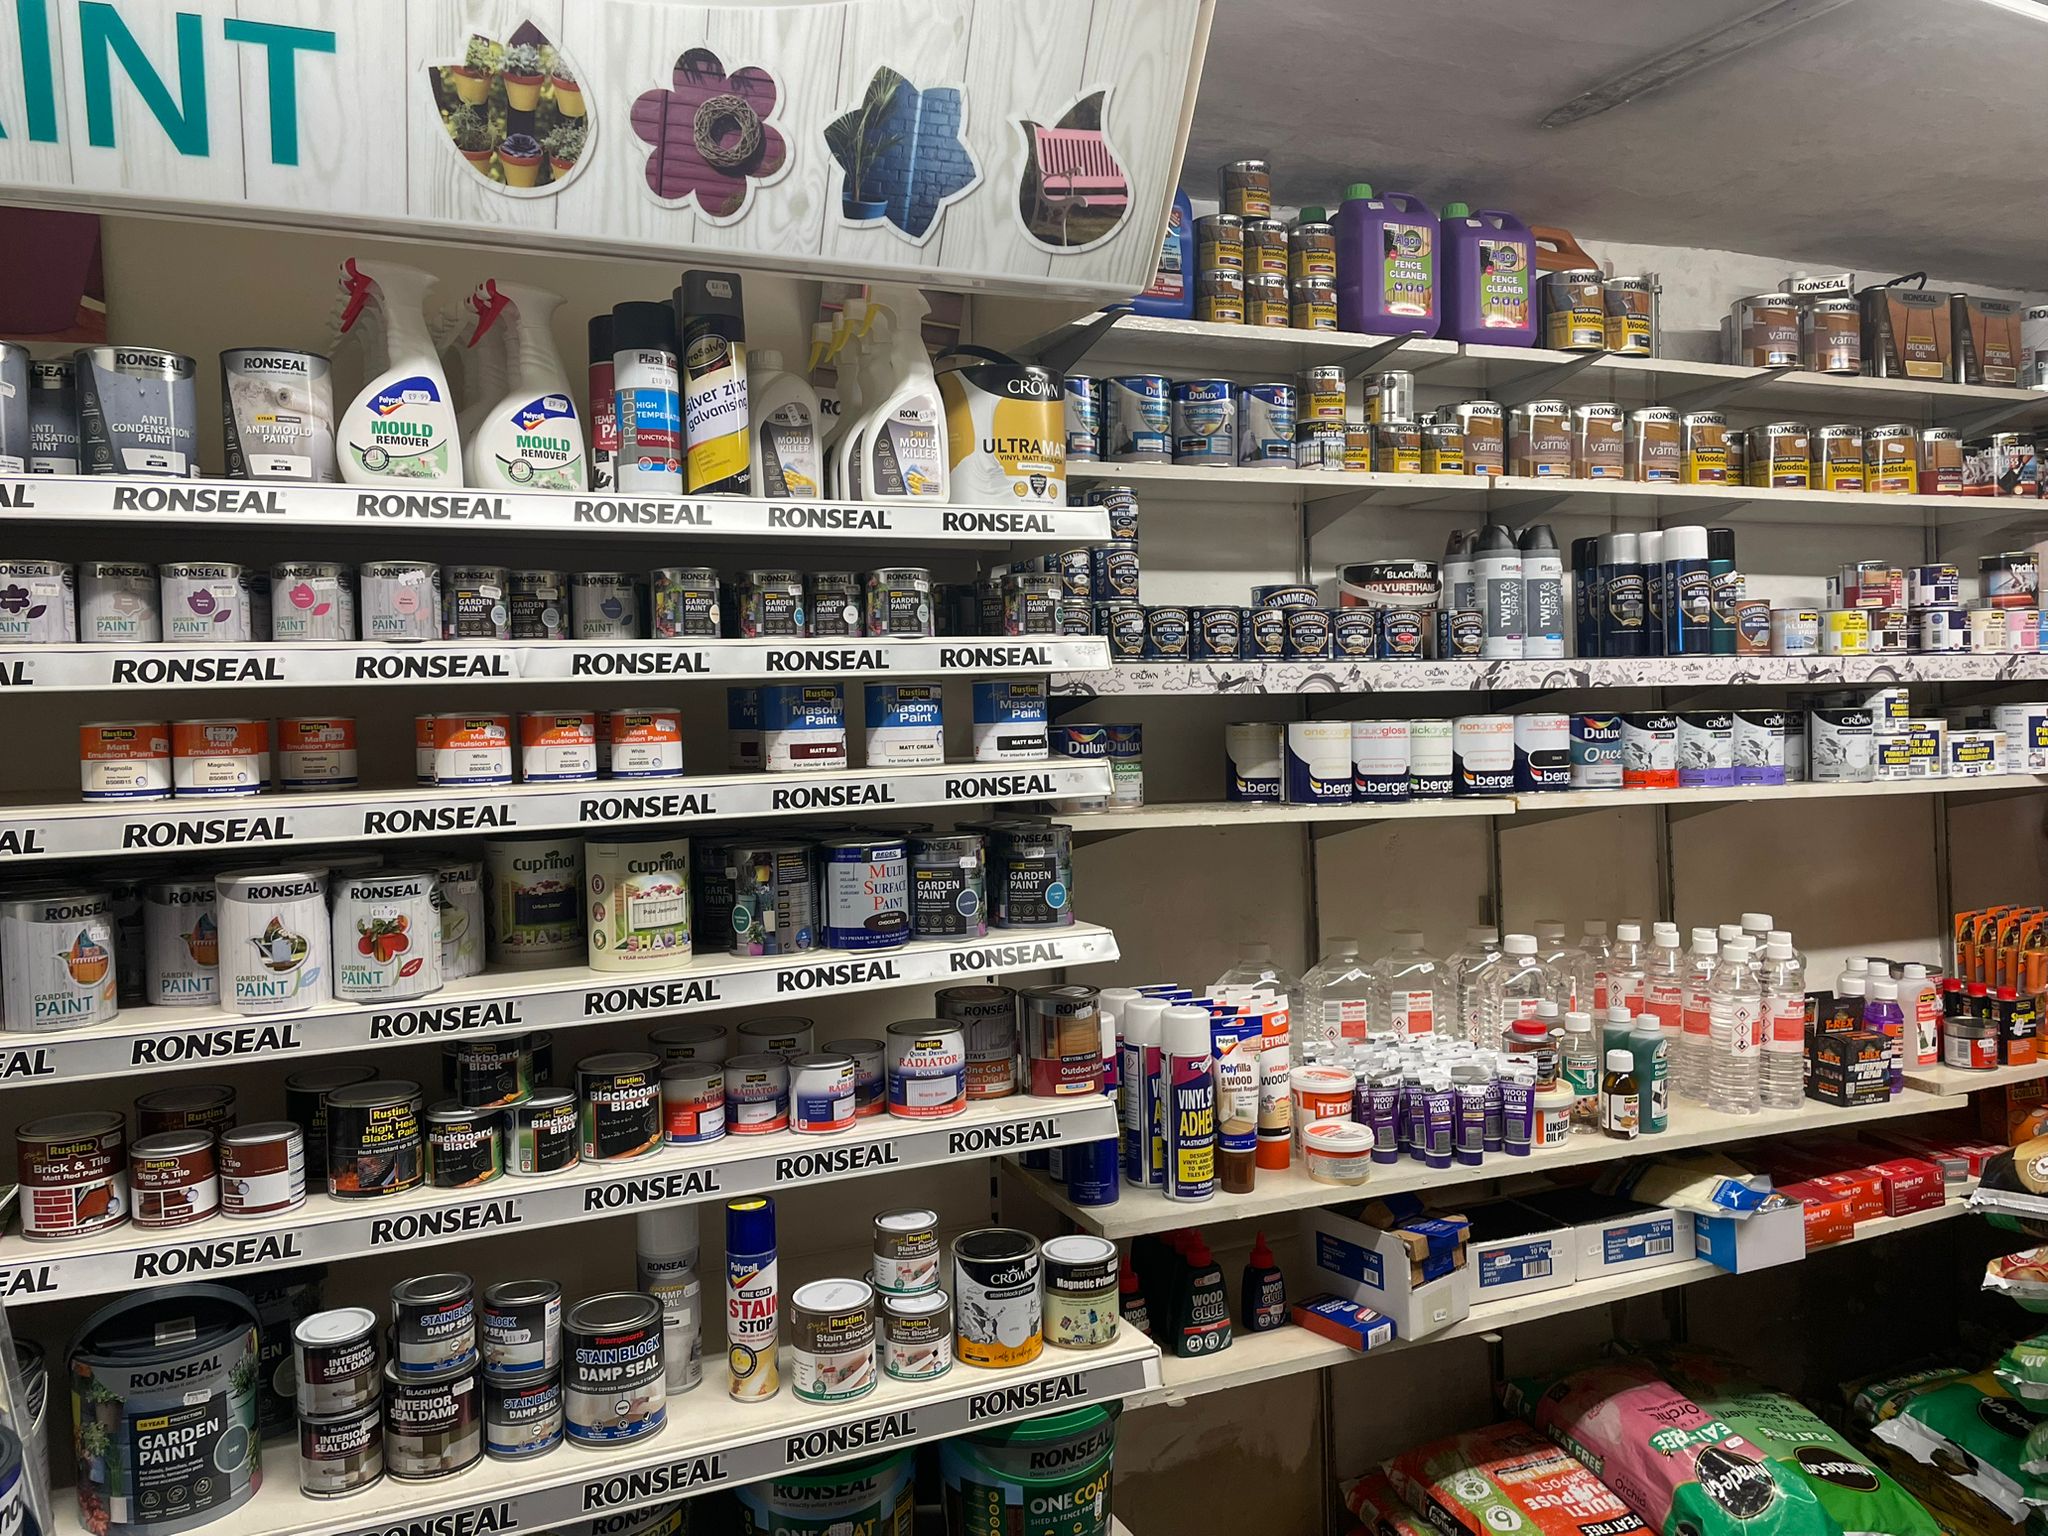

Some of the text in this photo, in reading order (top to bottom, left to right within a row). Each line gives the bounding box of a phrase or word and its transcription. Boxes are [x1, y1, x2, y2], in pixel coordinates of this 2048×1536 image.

[0, 0, 336, 166] INT
[1395, 261, 1421, 270] FENCE
[1390, 270, 1427, 280] CLEANER
[1492, 275, 1518, 284] FENCE
[1486, 285, 1523, 294] CLEANER
[1797, 280, 1846, 291] RONSEAL
[116, 353, 182, 370] RONSEAL
[244, 357, 308, 372] RONSEAL
[1008, 379, 1058, 398] CROWN
[1189, 391, 1217, 400] Dulux
[141, 416, 168, 425] ANTI
[112, 423, 190, 437] CONDENSATION
[246, 425, 312, 437] ANTI MOULD
[371, 421, 433, 437] MOULD
[1865, 428, 1909, 439] RONSEAL
[139, 434, 171, 445] PAINT
[263, 434, 295, 444] PAINT
[376, 435, 429, 447] REMOVER
[516, 435, 570, 451] MOULD
[1533, 440, 1569, 451] varnish
[521, 449, 567, 461] REMOVER
[1870, 465, 1913, 473] Woodstain
[113, 486, 286, 514] RONSEAL
[356, 494, 511, 520] RONSEAL
[574, 502, 712, 526] RONSEAL
[768, 506, 892, 530] RONSEAL
[943, 512, 1055, 533] RONSEAL
[174, 568, 226, 577] RONSEAL
[454, 572, 494, 580] RONSEAL
[887, 573, 921, 581] RONSEAL
[1387, 570, 1432, 580] BLACKFRIAR
[1365, 582, 1435, 592] POLYURETHANE
[1270, 594, 1317, 607] HAMMERITE
[1500, 590, 1512, 628] TWIST
[1152, 611, 1186, 622] HAMMERITE
[1337, 614, 1375, 625] HAMMERITE
[97, 621, 136, 631] PAINT
[173, 622, 208, 632] PAINT
[372, 620, 405, 629] PAINT
[572, 652, 710, 675] RONSEAL
[767, 650, 889, 670] RONSEAL
[940, 647, 1051, 667] RONSEAL
[112, 658, 284, 683] RONSEAL
[355, 655, 509, 678] RONSEAL
[1130, 672, 1159, 680] CROWN
[805, 688, 834, 699] Rustins
[1012, 685, 1039, 695] Rustins
[887, 703, 938, 715] Masonry
[805, 713, 837, 725] Paint
[900, 713, 932, 723] Paint
[1647, 718, 1675, 729] CROWN
[1584, 727, 1619, 739] Dulux
[1068, 740, 1106, 754] Dulux
[1108, 740, 1142, 753] Dulux
[1584, 747, 1622, 762] Once
[945, 774, 1057, 799] RONSEAL
[1367, 780, 1409, 796] berger
[1476, 775, 1514, 789] berger
[772, 783, 895, 809] RONSEAL
[579, 793, 716, 822] RONSEAL
[363, 804, 516, 835] RONSEAL
[123, 816, 293, 849] RONSEAL
[628, 854, 685, 875] Cuprinol
[1010, 870, 1051, 881] GARDEN
[248, 881, 319, 899] RONSEAL
[351, 883, 422, 899] RONSEAL
[917, 880, 960, 891] GARDEN
[1010, 880, 1039, 889] PAINT
[918, 891, 946, 900] PAINT
[873, 897, 903, 910] PAINT
[950, 942, 1063, 972] RONSEAL
[341, 971, 384, 985] PAINT
[777, 960, 900, 993] RONSEAL
[236, 980, 288, 996] PAINT
[35, 992, 73, 1000] GARDEN
[584, 978, 720, 1015] RONSEAL
[35, 996, 93, 1017] PAINT
[369, 1001, 522, 1039] RONSEAL
[1826, 1018, 1854, 1028] T-REX
[131, 1025, 301, 1065] RONSEAL
[900, 1055, 958, 1067] RADIATOR
[1858, 1049, 1881, 1060] T-REX
[1221, 1064, 1251, 1074] Polyfilla
[1226, 1076, 1252, 1086] WOOD
[610, 1098, 649, 1112] Black
[1178, 1089, 1204, 1109] VINYL
[1429, 1099, 1449, 1108] WOOD
[1462, 1096, 1483, 1104] WOOD
[1503, 1095, 1527, 1103] FILLER
[373, 1106, 408, 1121] Rustins
[1430, 1105, 1451, 1114] FILLER
[1462, 1103, 1484, 1111] FILLER
[1546, 1120, 1568, 1132] LINSEED
[429, 1127, 492, 1143] Blackboard
[949, 1119, 1060, 1154] RONSEAL
[50, 1142, 93, 1156] Rustins
[443, 1139, 477, 1151] Black
[34, 1156, 110, 1174] Brick & Tile
[776, 1142, 899, 1181] RONSEAL
[61, 1172, 80, 1180] Red
[82, 1168, 103, 1177] Paint
[1895, 1178, 1915, 1189] Delight
[584, 1172, 720, 1211] RONSEAL
[370, 1200, 522, 1244] RONSEAL
[134, 1234, 302, 1280] RONSEAL
[991, 1269, 1032, 1284] CROWN
[755, 1289, 770, 1297] COAT
[1263, 1281, 1283, 1293] WOOD
[1192, 1290, 1224, 1304] WOOD
[1263, 1291, 1284, 1304] GLUE
[1192, 1304, 1225, 1319] GLUE
[739, 1317, 774, 1333] STOP
[832, 1314, 862, 1327] Rustins
[576, 1337, 660, 1364] STAIN BLOCK
[130, 1356, 222, 1388] RONSEAL
[579, 1358, 658, 1381] DAMP SEAL
[394, 1395, 452, 1410] INTERIOR
[969, 1374, 1087, 1420] RONSEAL
[391, 1402, 459, 1422] SEAL DAMP
[138, 1417, 219, 1450] GARDEN
[320, 1428, 366, 1444] INTERIOR
[786, 1413, 916, 1463] RONSEAL
[139, 1442, 197, 1465] PAINT
[1575, 1447, 1602, 1471] FREE
[582, 1456, 727, 1511] RONSEAL
